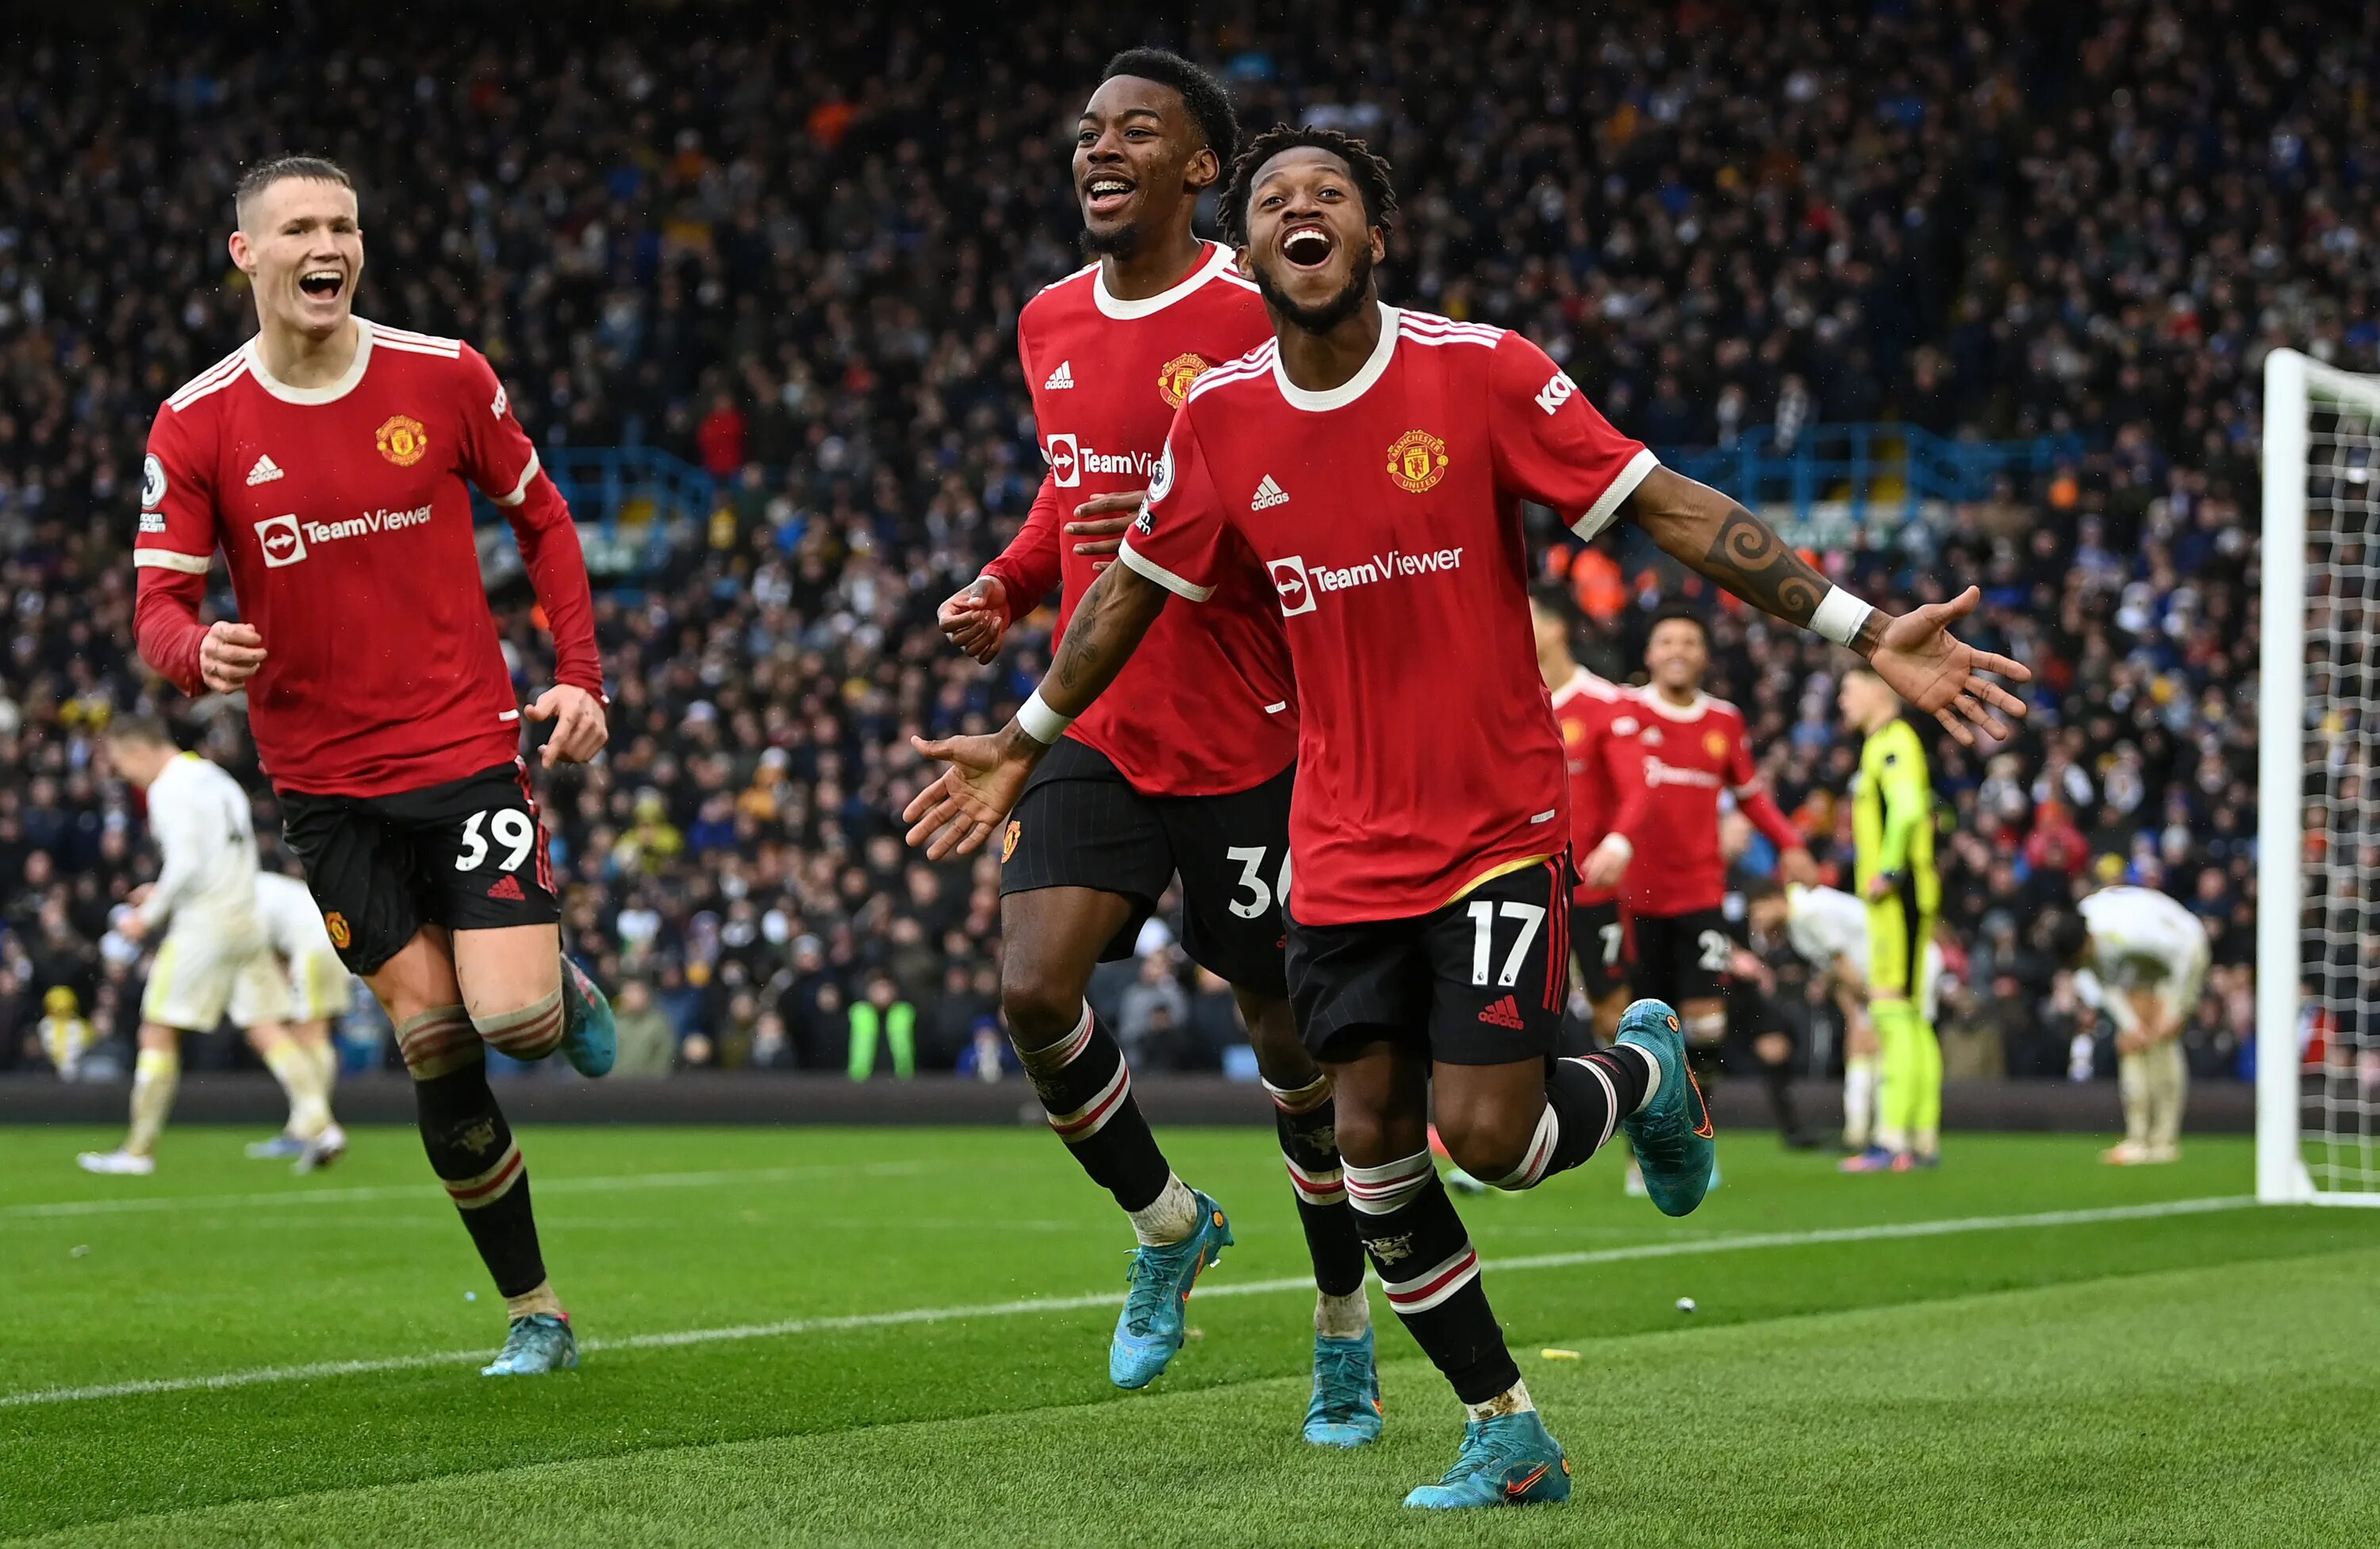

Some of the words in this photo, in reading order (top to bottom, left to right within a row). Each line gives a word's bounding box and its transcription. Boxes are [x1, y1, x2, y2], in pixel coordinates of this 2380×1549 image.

[1045, 379, 1074, 390] adidas
[1392, 434, 1441, 458] MANCHESTER
[246, 468, 285, 486] adidas
[1403, 475, 1437, 489] UNITED
[1251, 492, 1290, 511] adidas
[301, 504, 432, 544] TeamViewer
[1308, 548, 1464, 592] TeamViewer
[455, 808, 534, 872] 39
[1467, 901, 1546, 986] 17
[1698, 929, 1731, 971] 2
[1478, 1011, 1524, 1030] adidas
